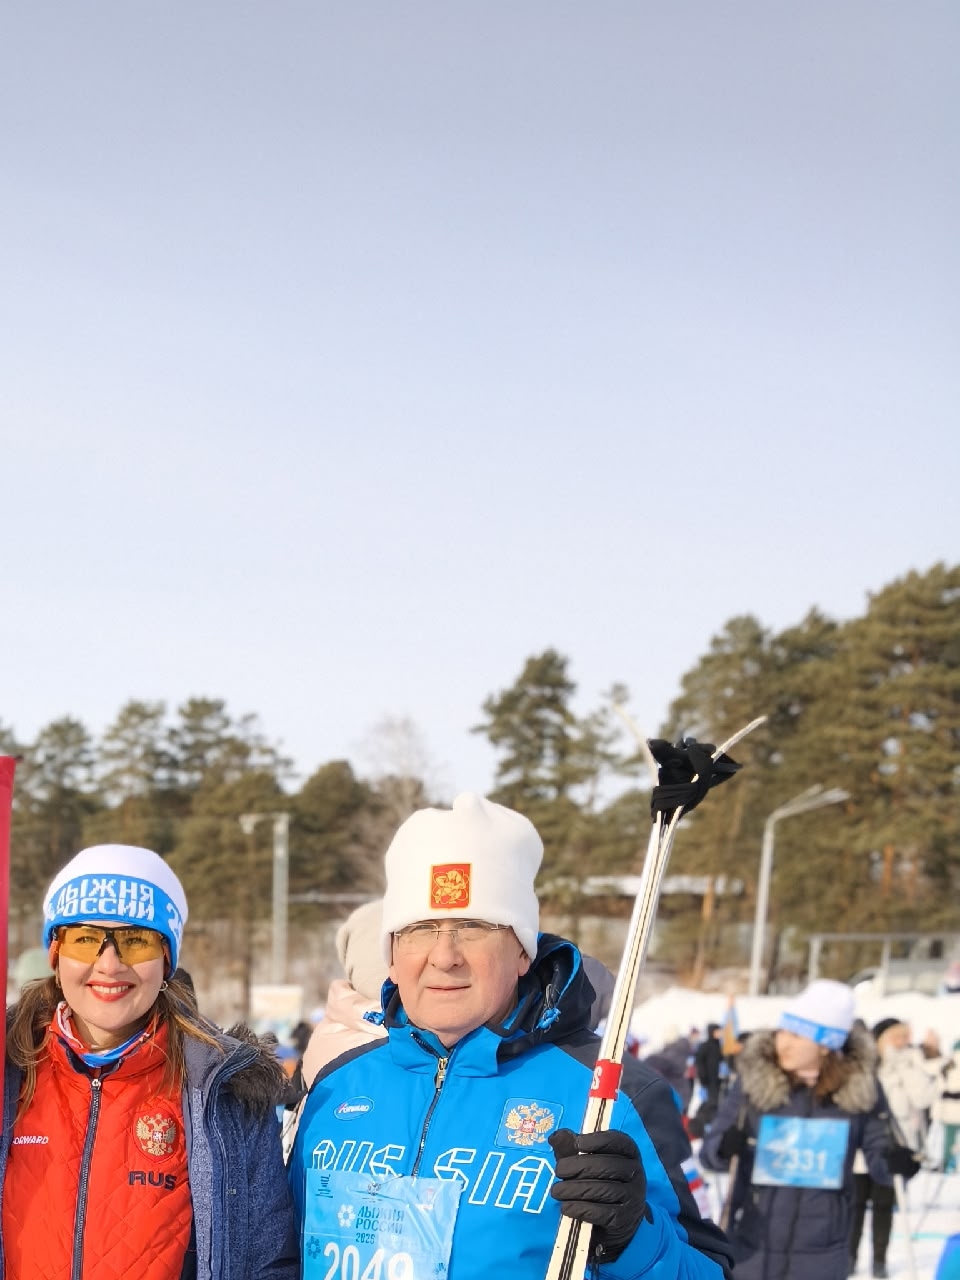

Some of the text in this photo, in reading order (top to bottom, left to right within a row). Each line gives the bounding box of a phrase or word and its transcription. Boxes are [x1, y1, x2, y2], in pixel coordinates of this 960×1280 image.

[57, 878, 154, 909] ЛЫЖНЯ
[57, 897, 154, 921] ОССИИ
[13, 1135, 49, 1145] ORWARD
[128, 1171, 178, 1190] RUS
